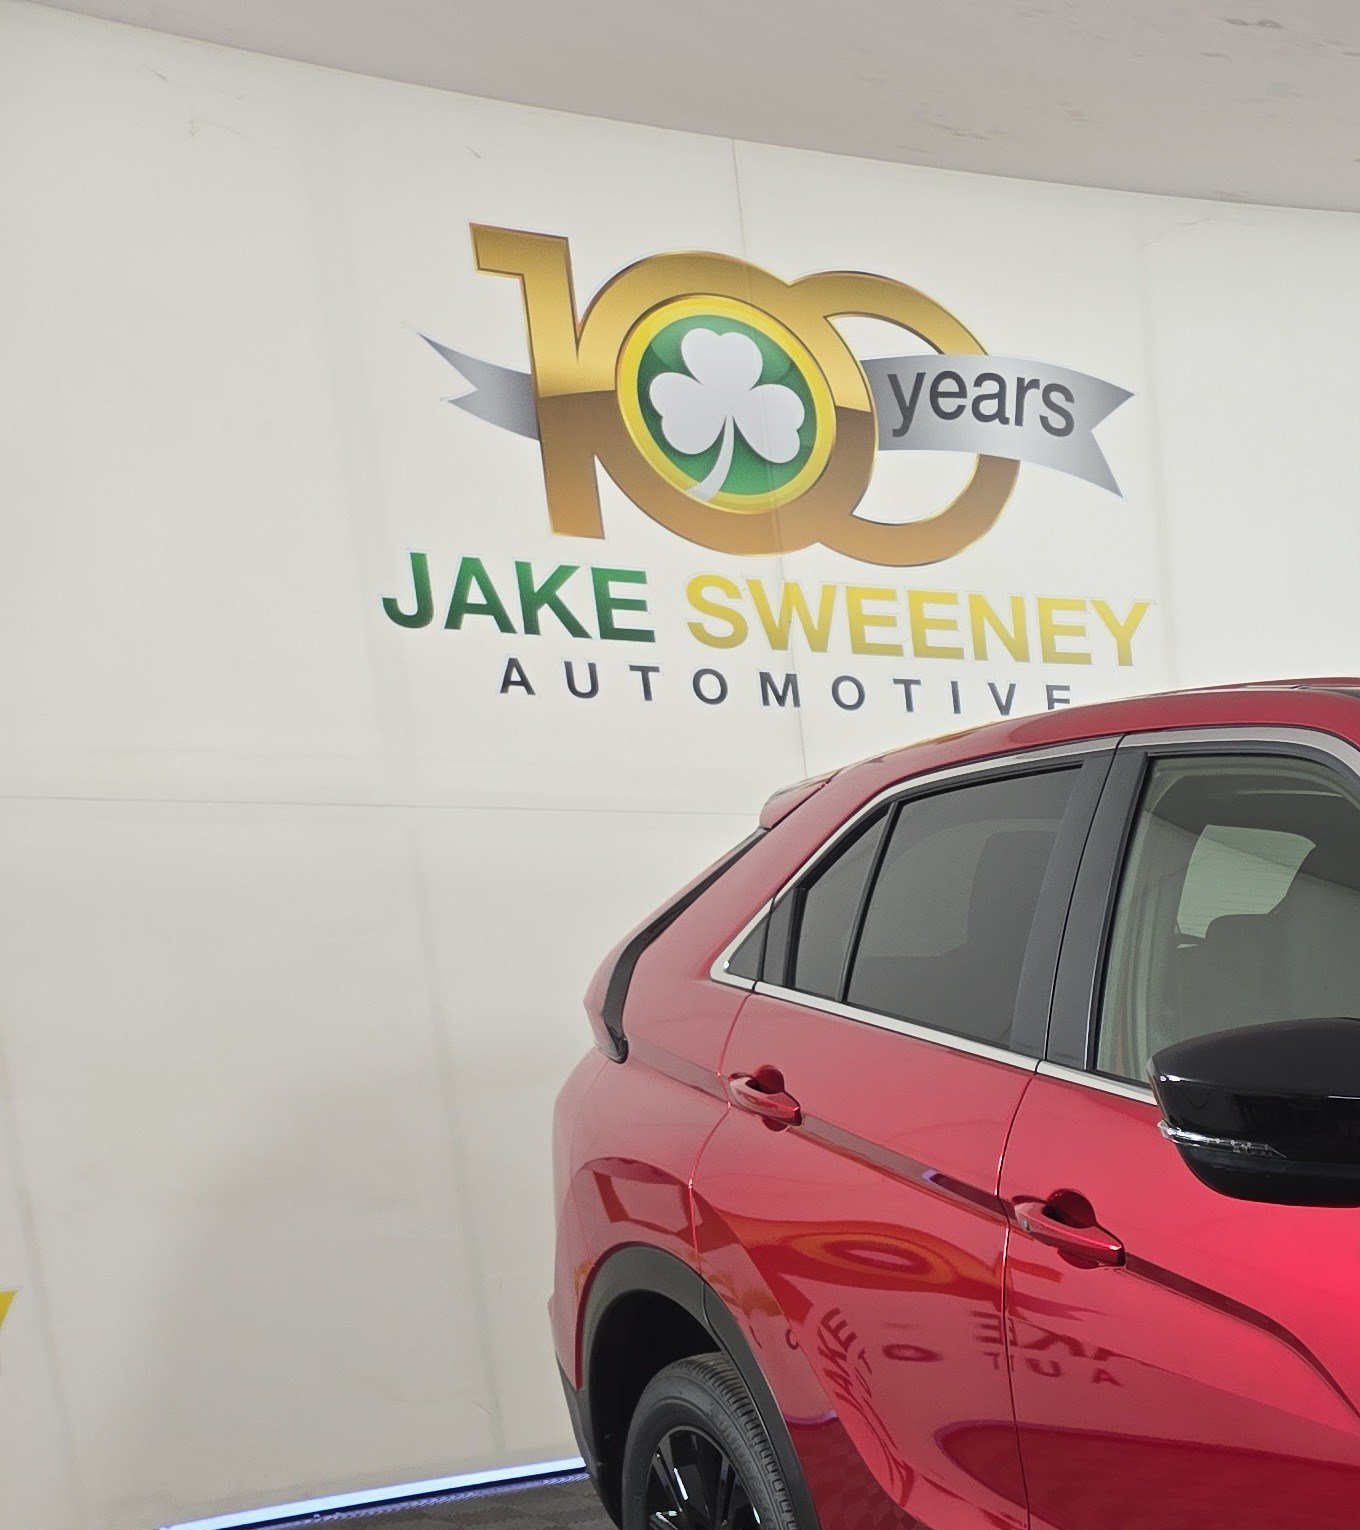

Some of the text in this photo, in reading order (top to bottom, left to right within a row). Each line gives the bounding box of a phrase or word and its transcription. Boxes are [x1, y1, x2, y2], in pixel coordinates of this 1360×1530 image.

[469, 223, 1020, 567] 100
[887, 369, 1075, 438] years
[381, 551, 1151, 668] JAKE SWEENEY
[499, 657, 1071, 716] AUTOMOTIVE
